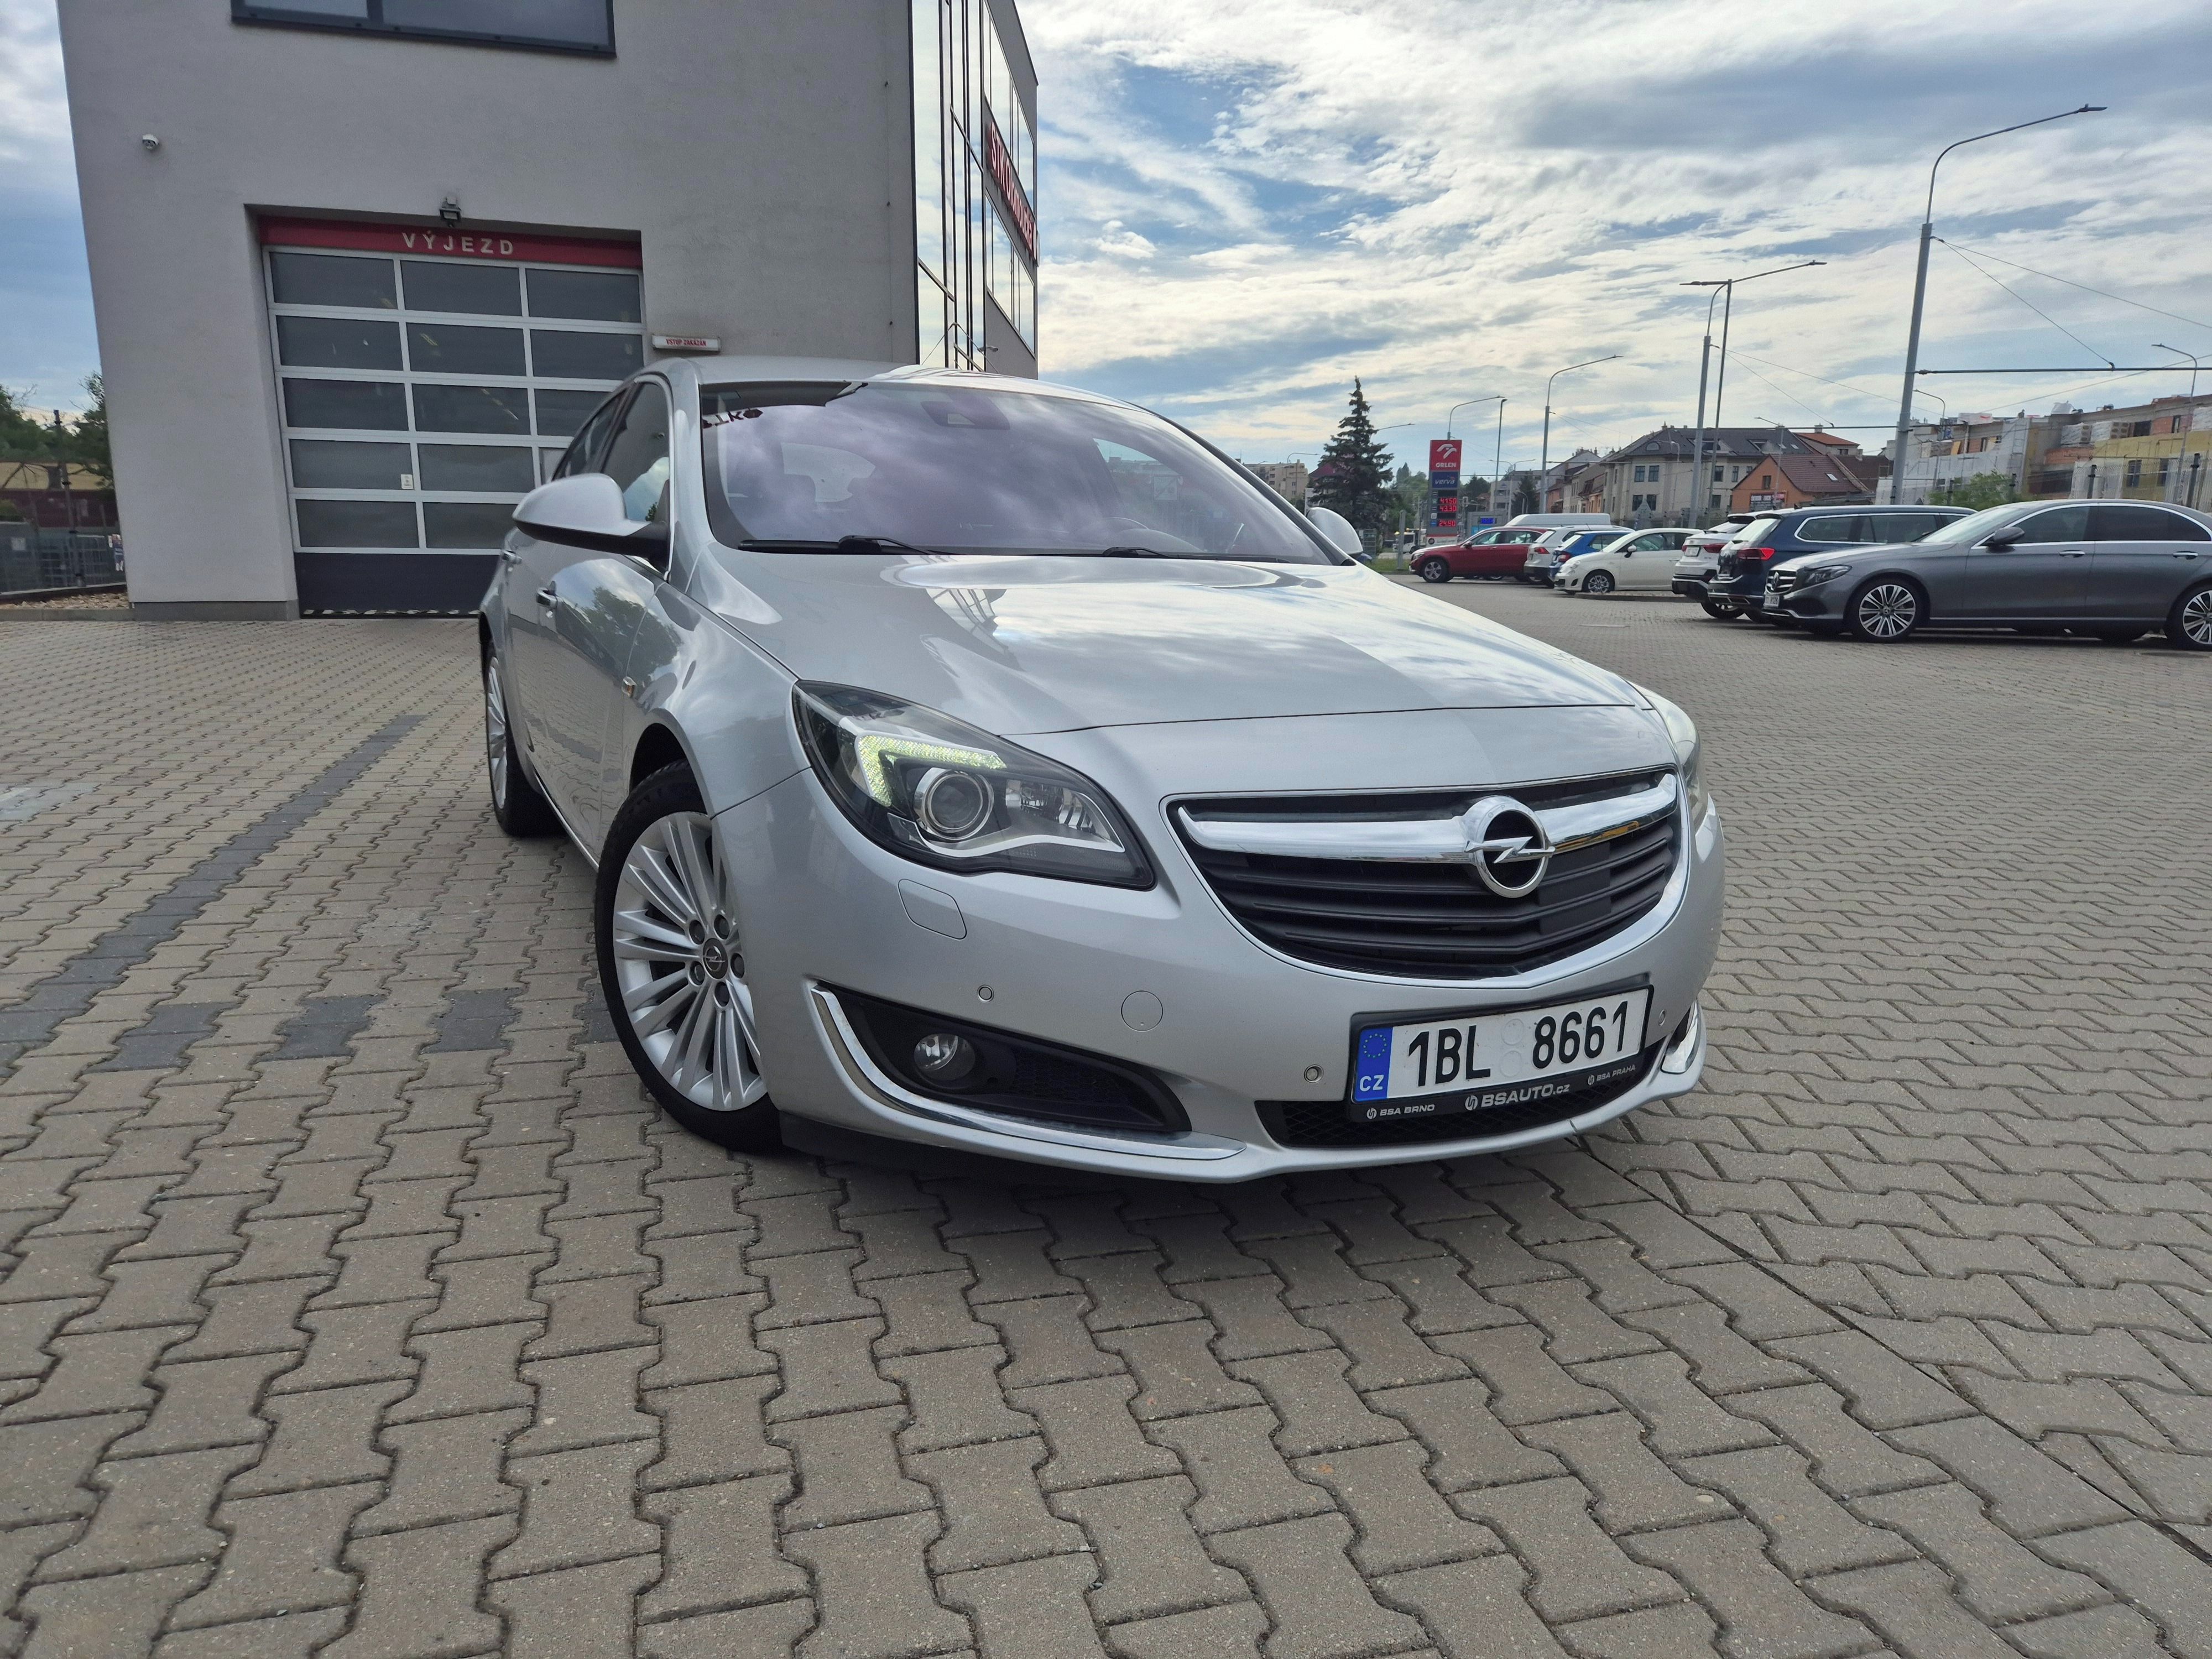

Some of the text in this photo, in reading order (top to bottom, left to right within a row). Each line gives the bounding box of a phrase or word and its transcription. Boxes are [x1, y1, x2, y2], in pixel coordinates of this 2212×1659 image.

[992, 121, 1032, 251] STK Olomoucká
[402, 230, 514, 255] VÝJEZD
[1488, 804, 1532, 818] OPEL
[1408, 1000, 1628, 1087] 1BL 8661
[1359, 1073, 1384, 1093] CZ
[1596, 1064, 1636, 1082] BSA PRAHA
[1481, 1083, 1571, 1108] BSAUTO.cz
[1379, 1104, 1436, 1117] BSA BRNO
